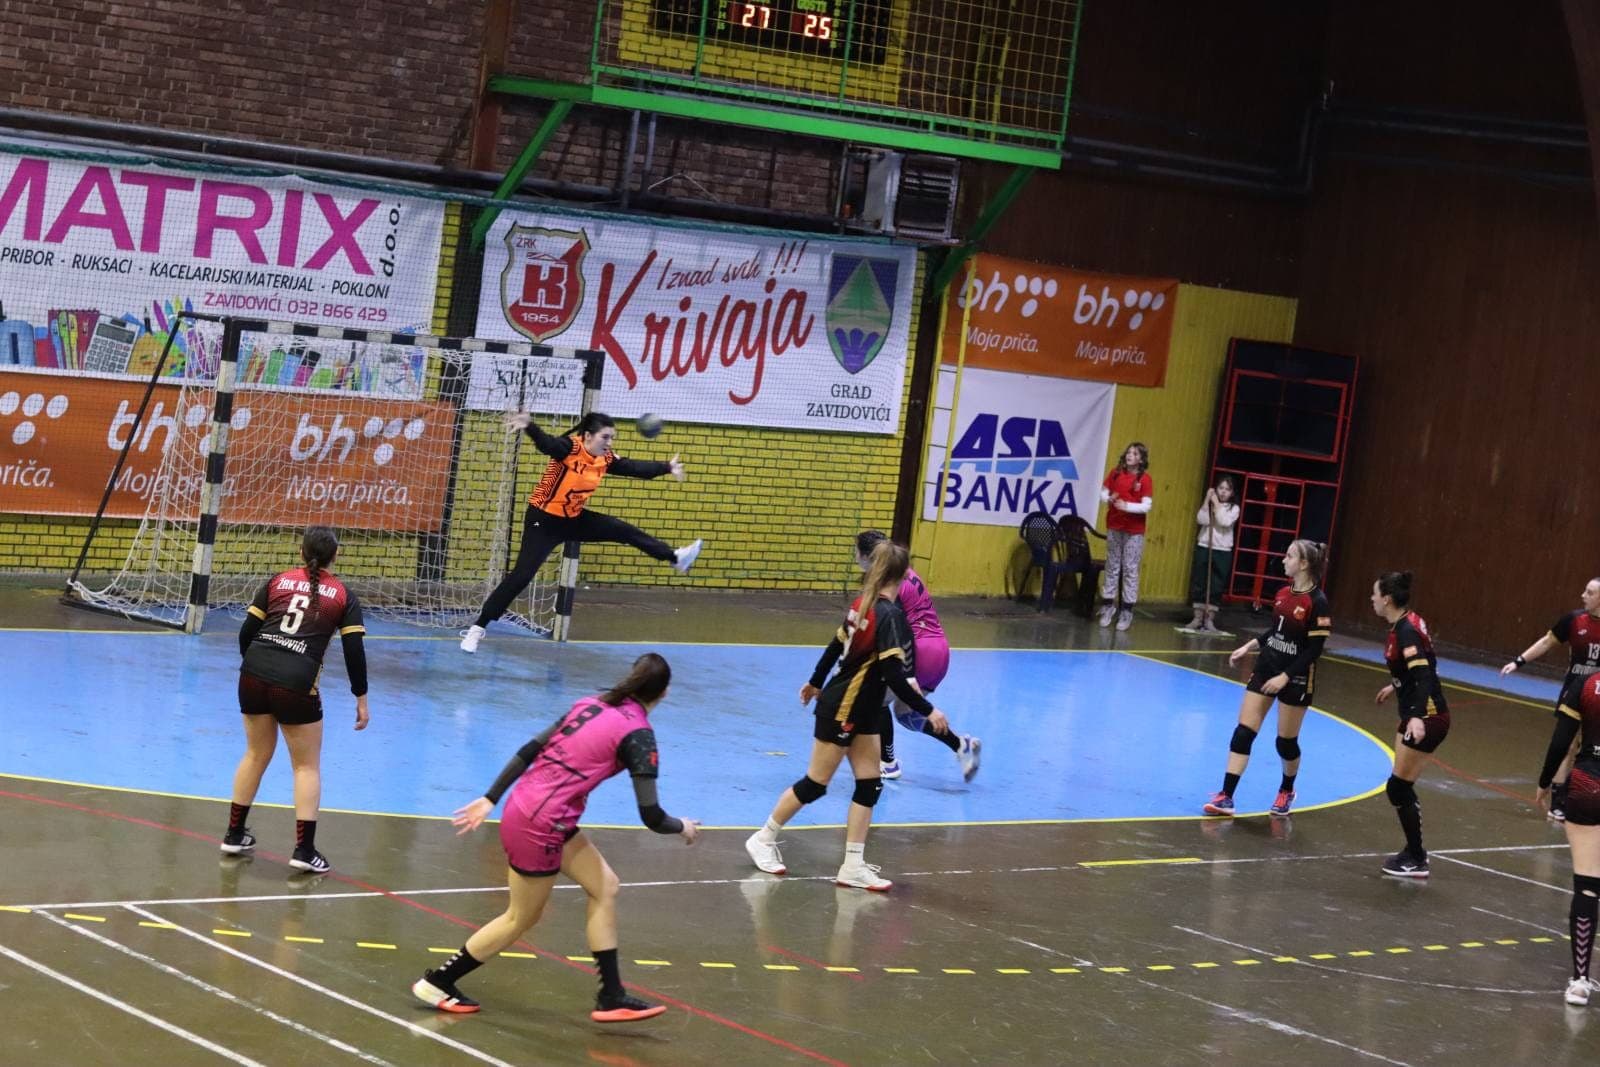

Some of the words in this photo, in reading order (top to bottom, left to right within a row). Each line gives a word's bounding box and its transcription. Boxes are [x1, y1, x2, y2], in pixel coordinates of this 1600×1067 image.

[742, 4, 770, 29] 27
[804, 14, 832, 39] 25
[379, 202, 401, 277] d.o.o.
[515, 236, 537, 249] ŽRK
[1, 247, 55, 266] PRIBOR
[72, 253, 133, 274] RUKSACI
[150, 262, 243, 285] KACELARIJSKI
[244, 271, 314, 292] MATERIJAL
[331, 280, 390, 299] POKLONI
[656, 258, 720, 290] Iznad
[721, 251, 761, 283] svih
[957, 271, 1010, 313] bh
[1073, 284, 1120, 328] bh
[288, 300, 318, 316] 032
[322, 304, 353, 319] 866
[357, 307, 388, 322] 429
[521, 312, 561, 324] 1954
[590, 249, 815, 405] Krivaja
[966, 326, 1000, 351] Moja
[1000, 333, 1039, 353] priča.
[1075, 340, 1110, 365] Moja
[1110, 344, 1147, 365] priča.
[492, 367, 575, 390] "KRVAJA"
[831, 383, 872, 400] GRAD
[107, 400, 178, 454] bh
[806, 402, 892, 421] ZAVIDOVIĆI
[290, 412, 356, 464] bh
[940, 413, 1080, 480] ASA
[0, 459, 54, 488] riča.
[286, 475, 348, 508] Moja
[349, 479, 413, 509] priča.
[933, 471, 1078, 517] BANKA
[296, 581, 337, 599] KRAJA
[279, 594, 310, 635] 5
